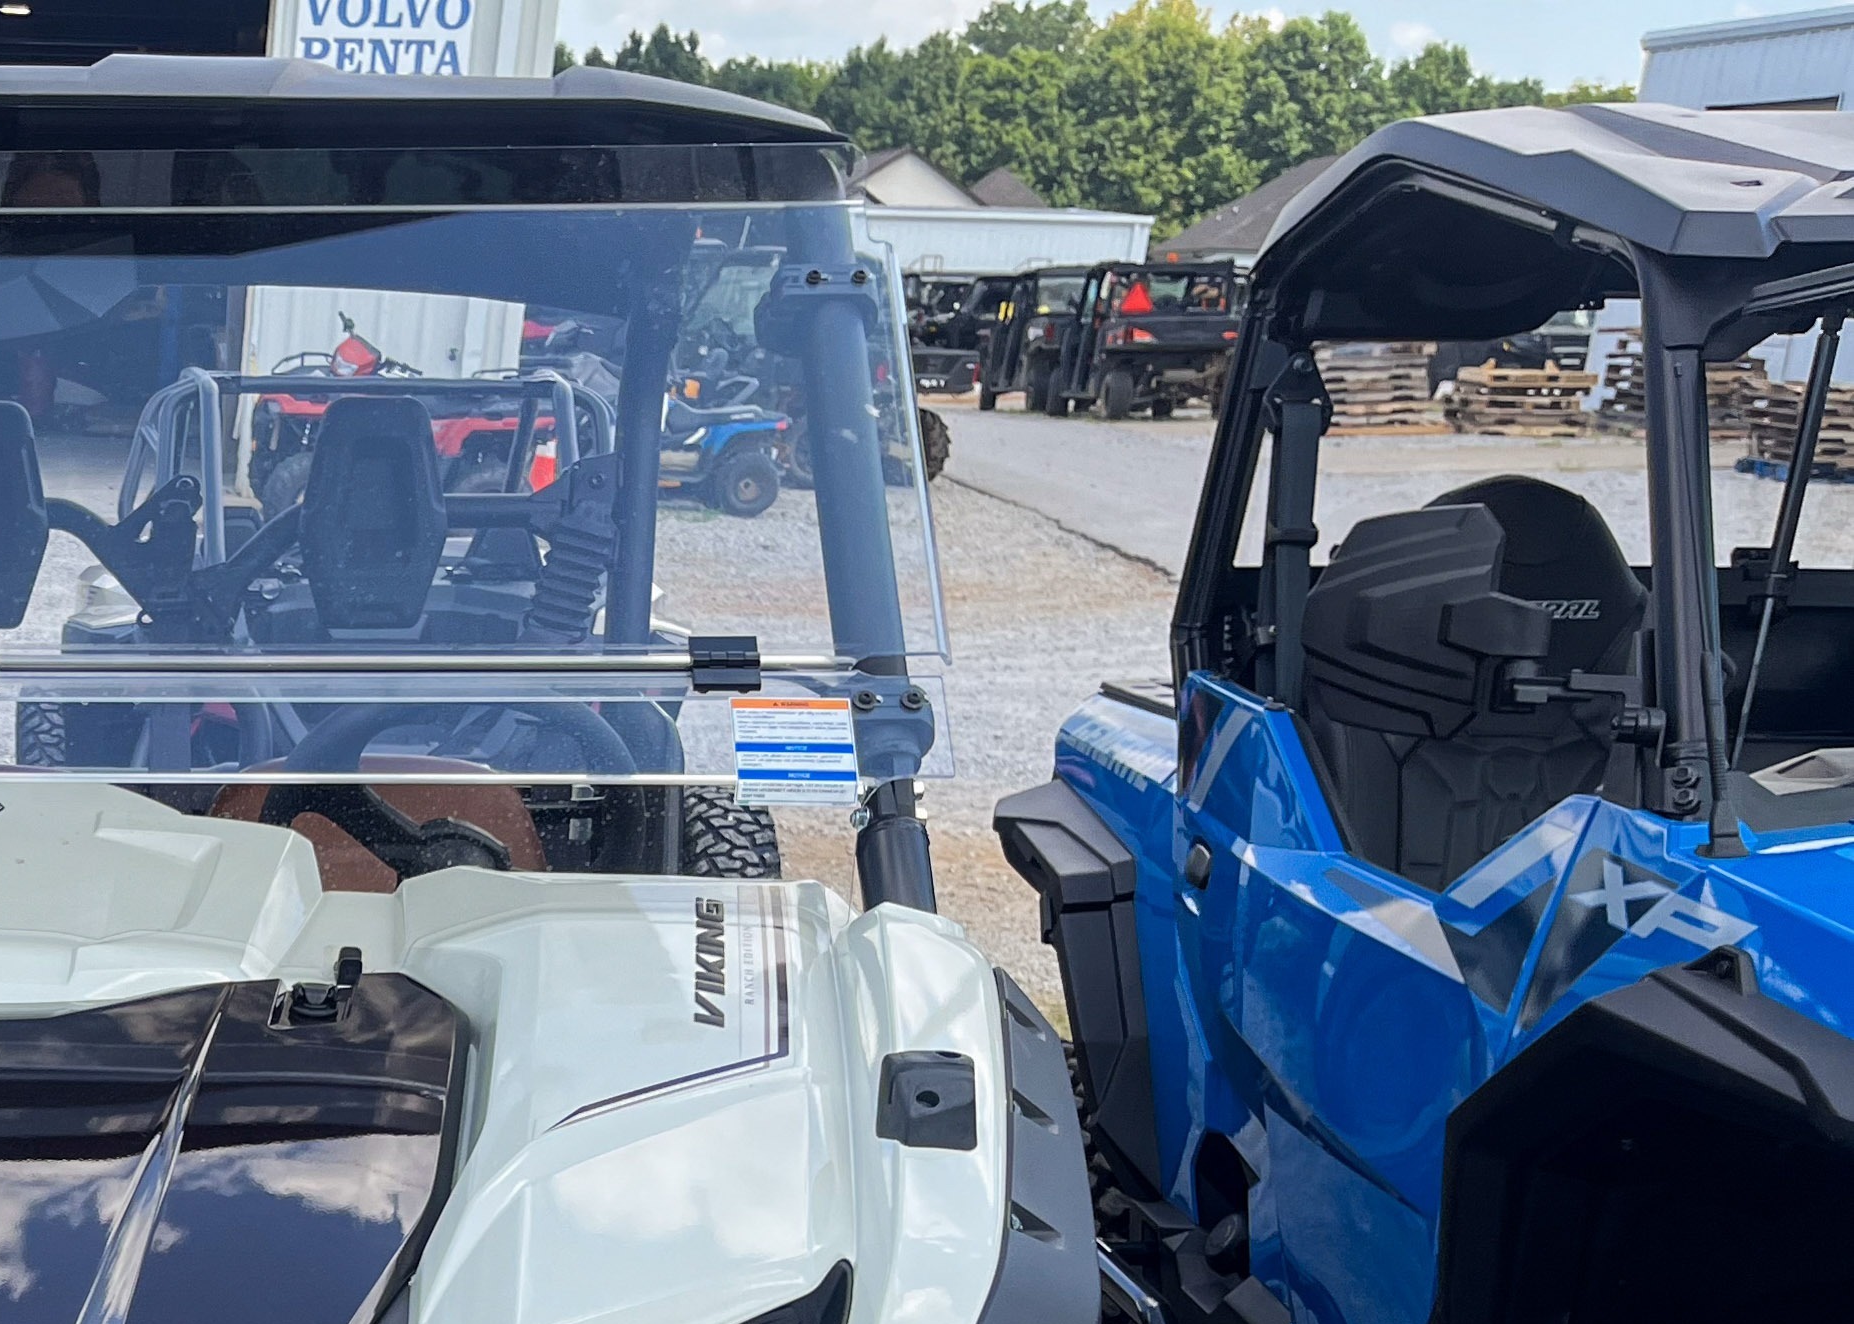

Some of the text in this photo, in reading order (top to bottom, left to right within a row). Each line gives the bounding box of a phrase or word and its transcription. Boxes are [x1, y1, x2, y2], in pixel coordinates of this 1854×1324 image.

[307, 0, 472, 30] VOLVO
[299, 36, 463, 76] PENTA
[1567, 857, 1759, 951] XP
[693, 896, 725, 1028] VIKING
